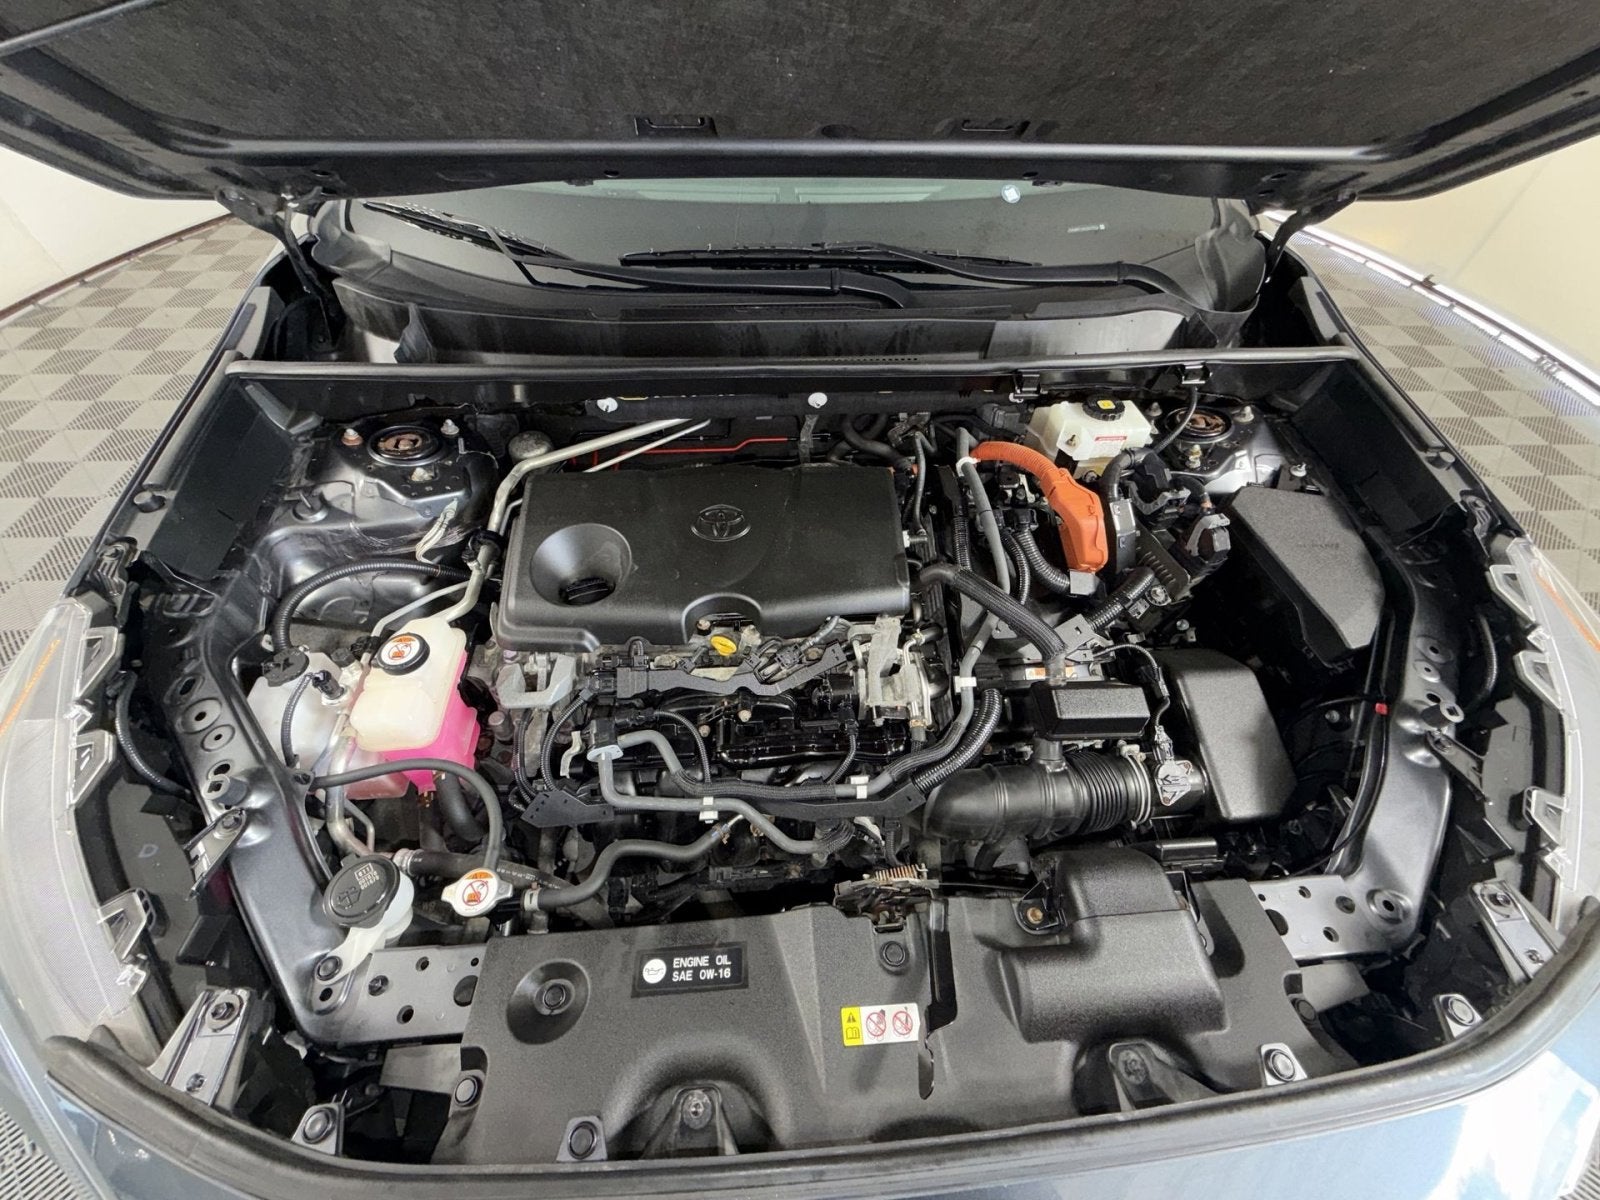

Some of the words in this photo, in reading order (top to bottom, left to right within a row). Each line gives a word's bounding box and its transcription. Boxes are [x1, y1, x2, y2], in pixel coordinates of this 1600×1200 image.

[673, 955, 709, 968] ENGINE
[715, 954, 731, 965] OIL
[672, 970, 693, 981] SAE
[699, 968, 731, 979] 0W-16
